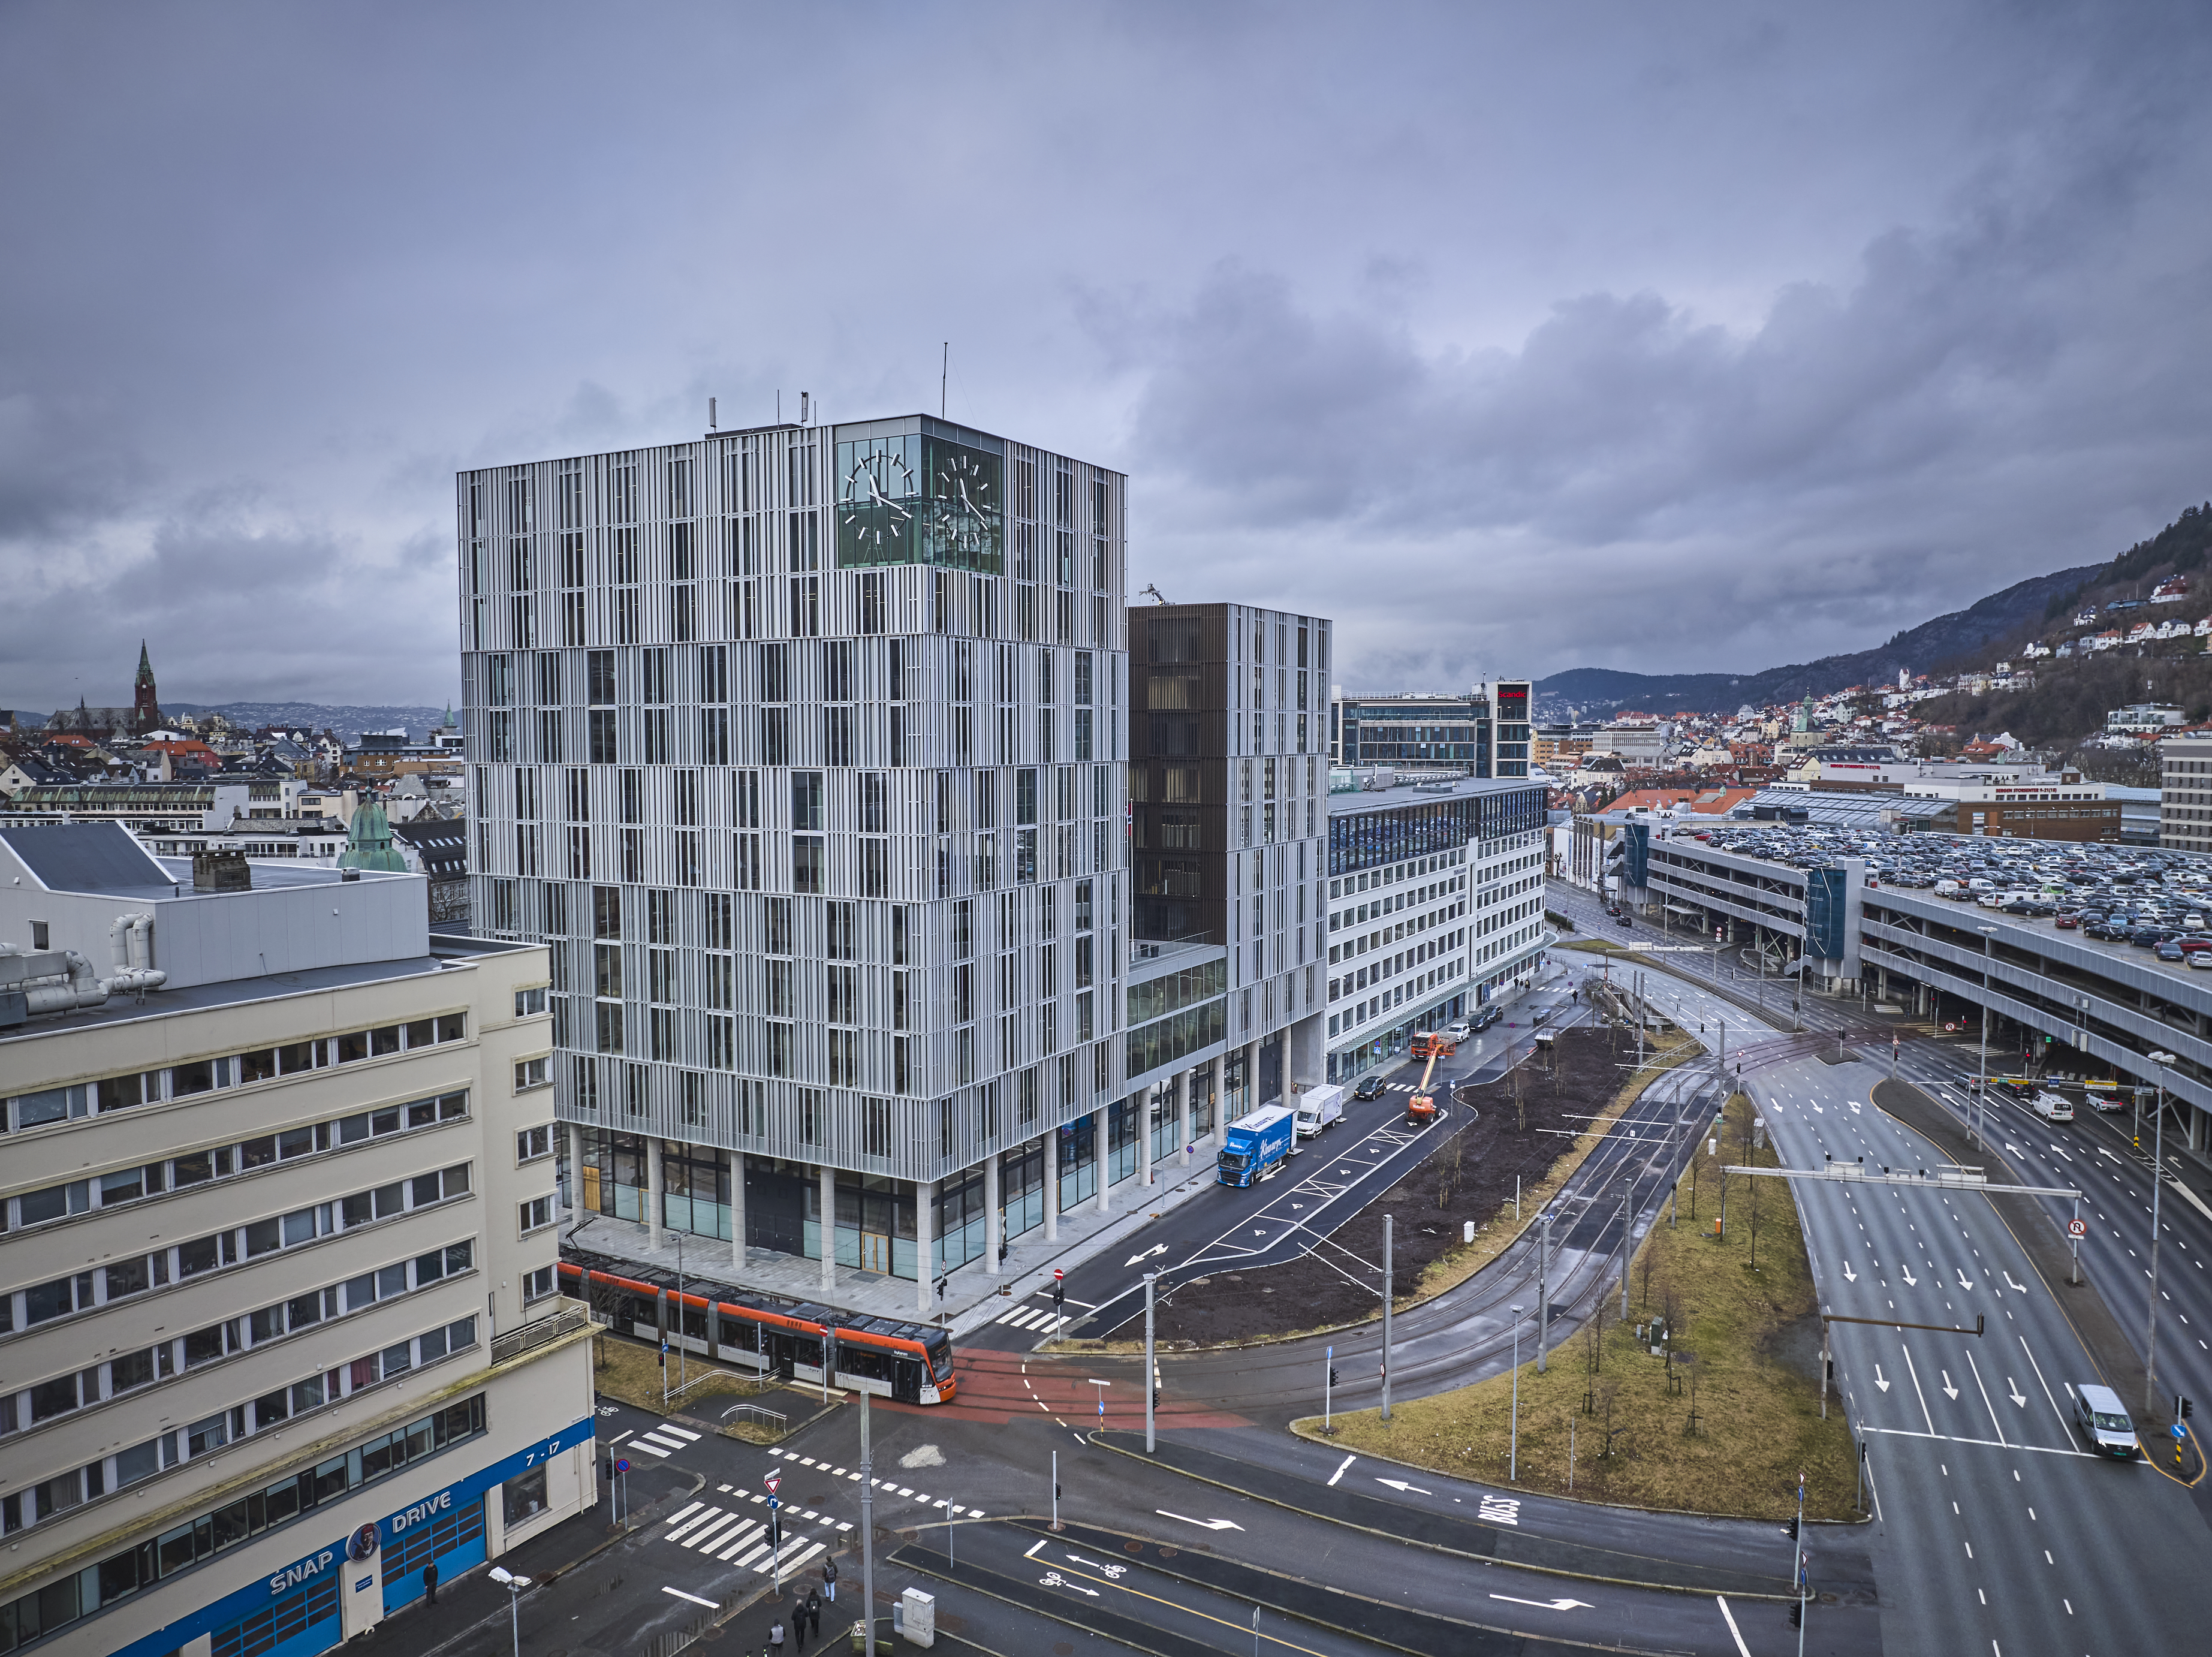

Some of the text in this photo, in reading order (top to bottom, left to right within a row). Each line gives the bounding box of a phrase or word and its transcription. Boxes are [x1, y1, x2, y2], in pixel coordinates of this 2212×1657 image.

[1240, 1116, 1276, 1130] Kinnarps
[1259, 1138, 1281, 1159] Kinnarps
[526, 1453, 534, 1467] 7
[549, 1441, 560, 1455] 17
[393, 1491, 451, 1533] DRIVE
[1478, 1495, 1521, 1526] BUSS
[270, 1551, 333, 1595] SNAP
